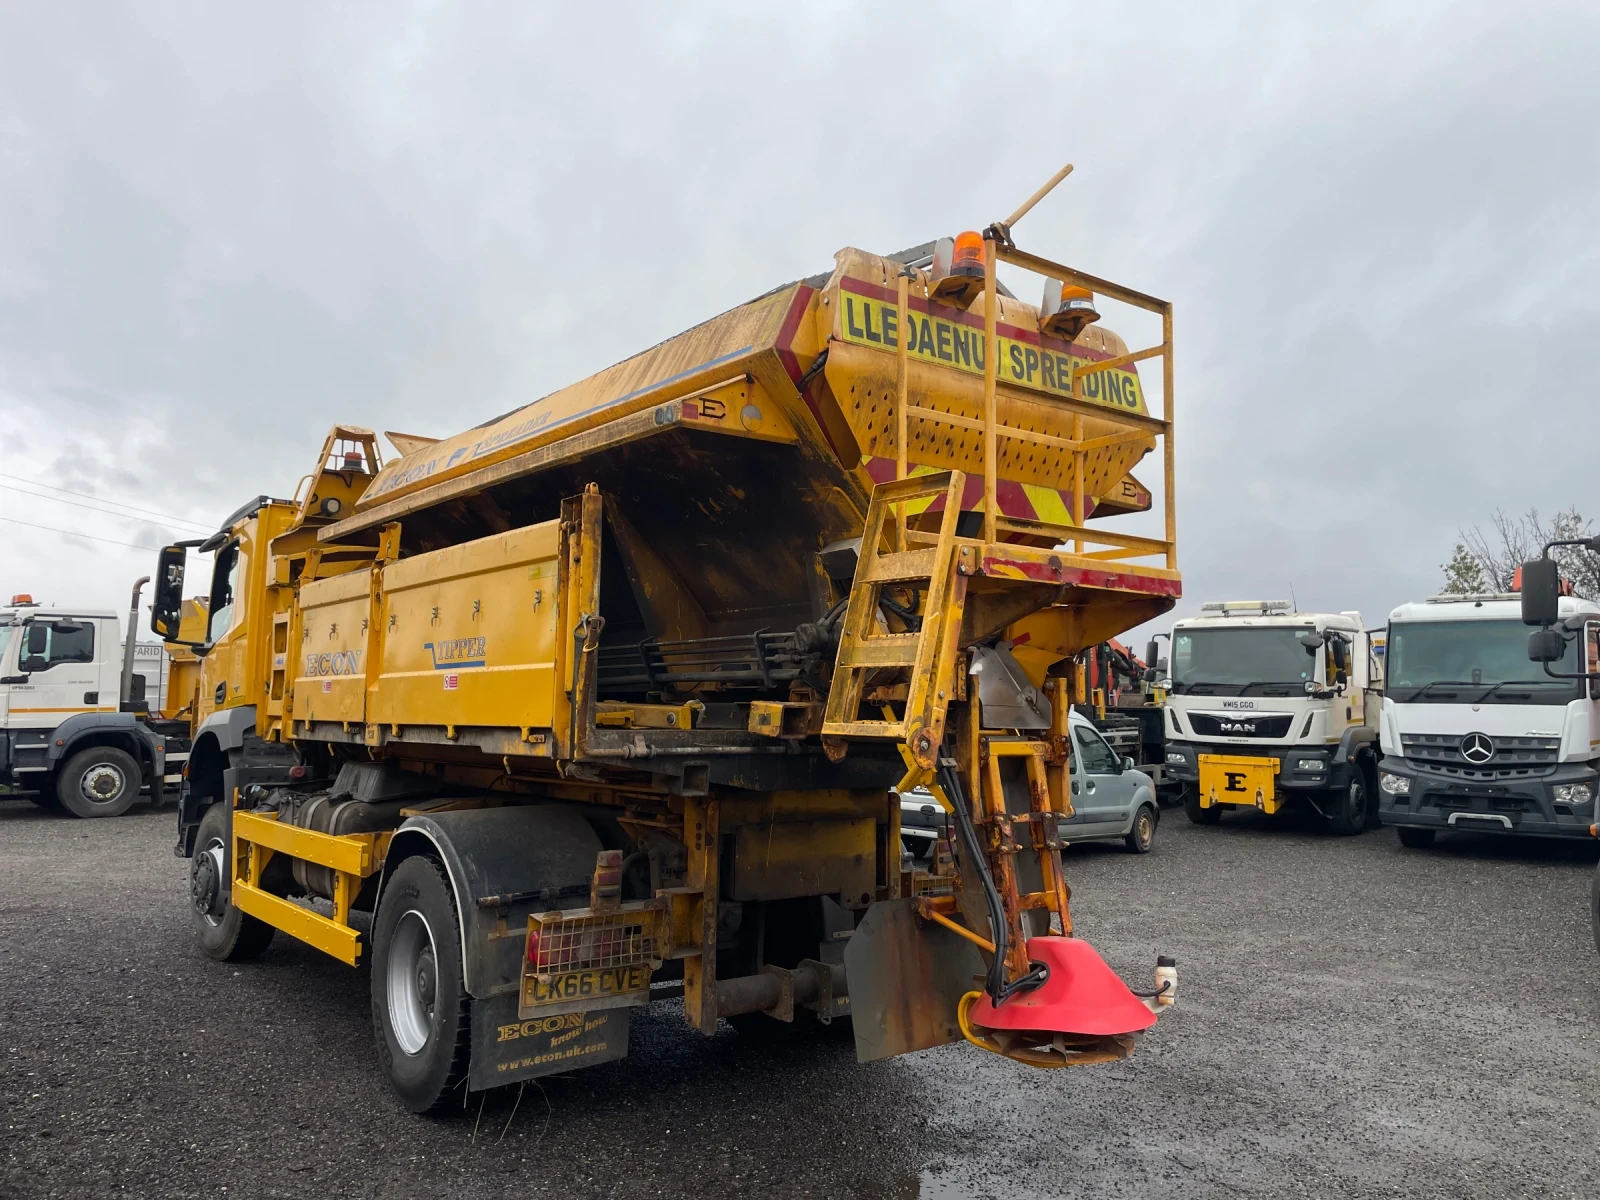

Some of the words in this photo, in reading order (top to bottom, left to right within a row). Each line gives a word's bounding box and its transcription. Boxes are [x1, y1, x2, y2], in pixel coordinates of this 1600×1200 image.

[437, 637, 486, 660] TIPPER
[305, 650, 363, 677] ECON
[1223, 701, 1238, 709] WM15
[1221, 723, 1256, 732] MAN
[600, 968, 640, 993] CVE
[497, 1011, 586, 1041] ECON
[550, 1027, 582, 1048] know
[584, 1014, 608, 1033] how
